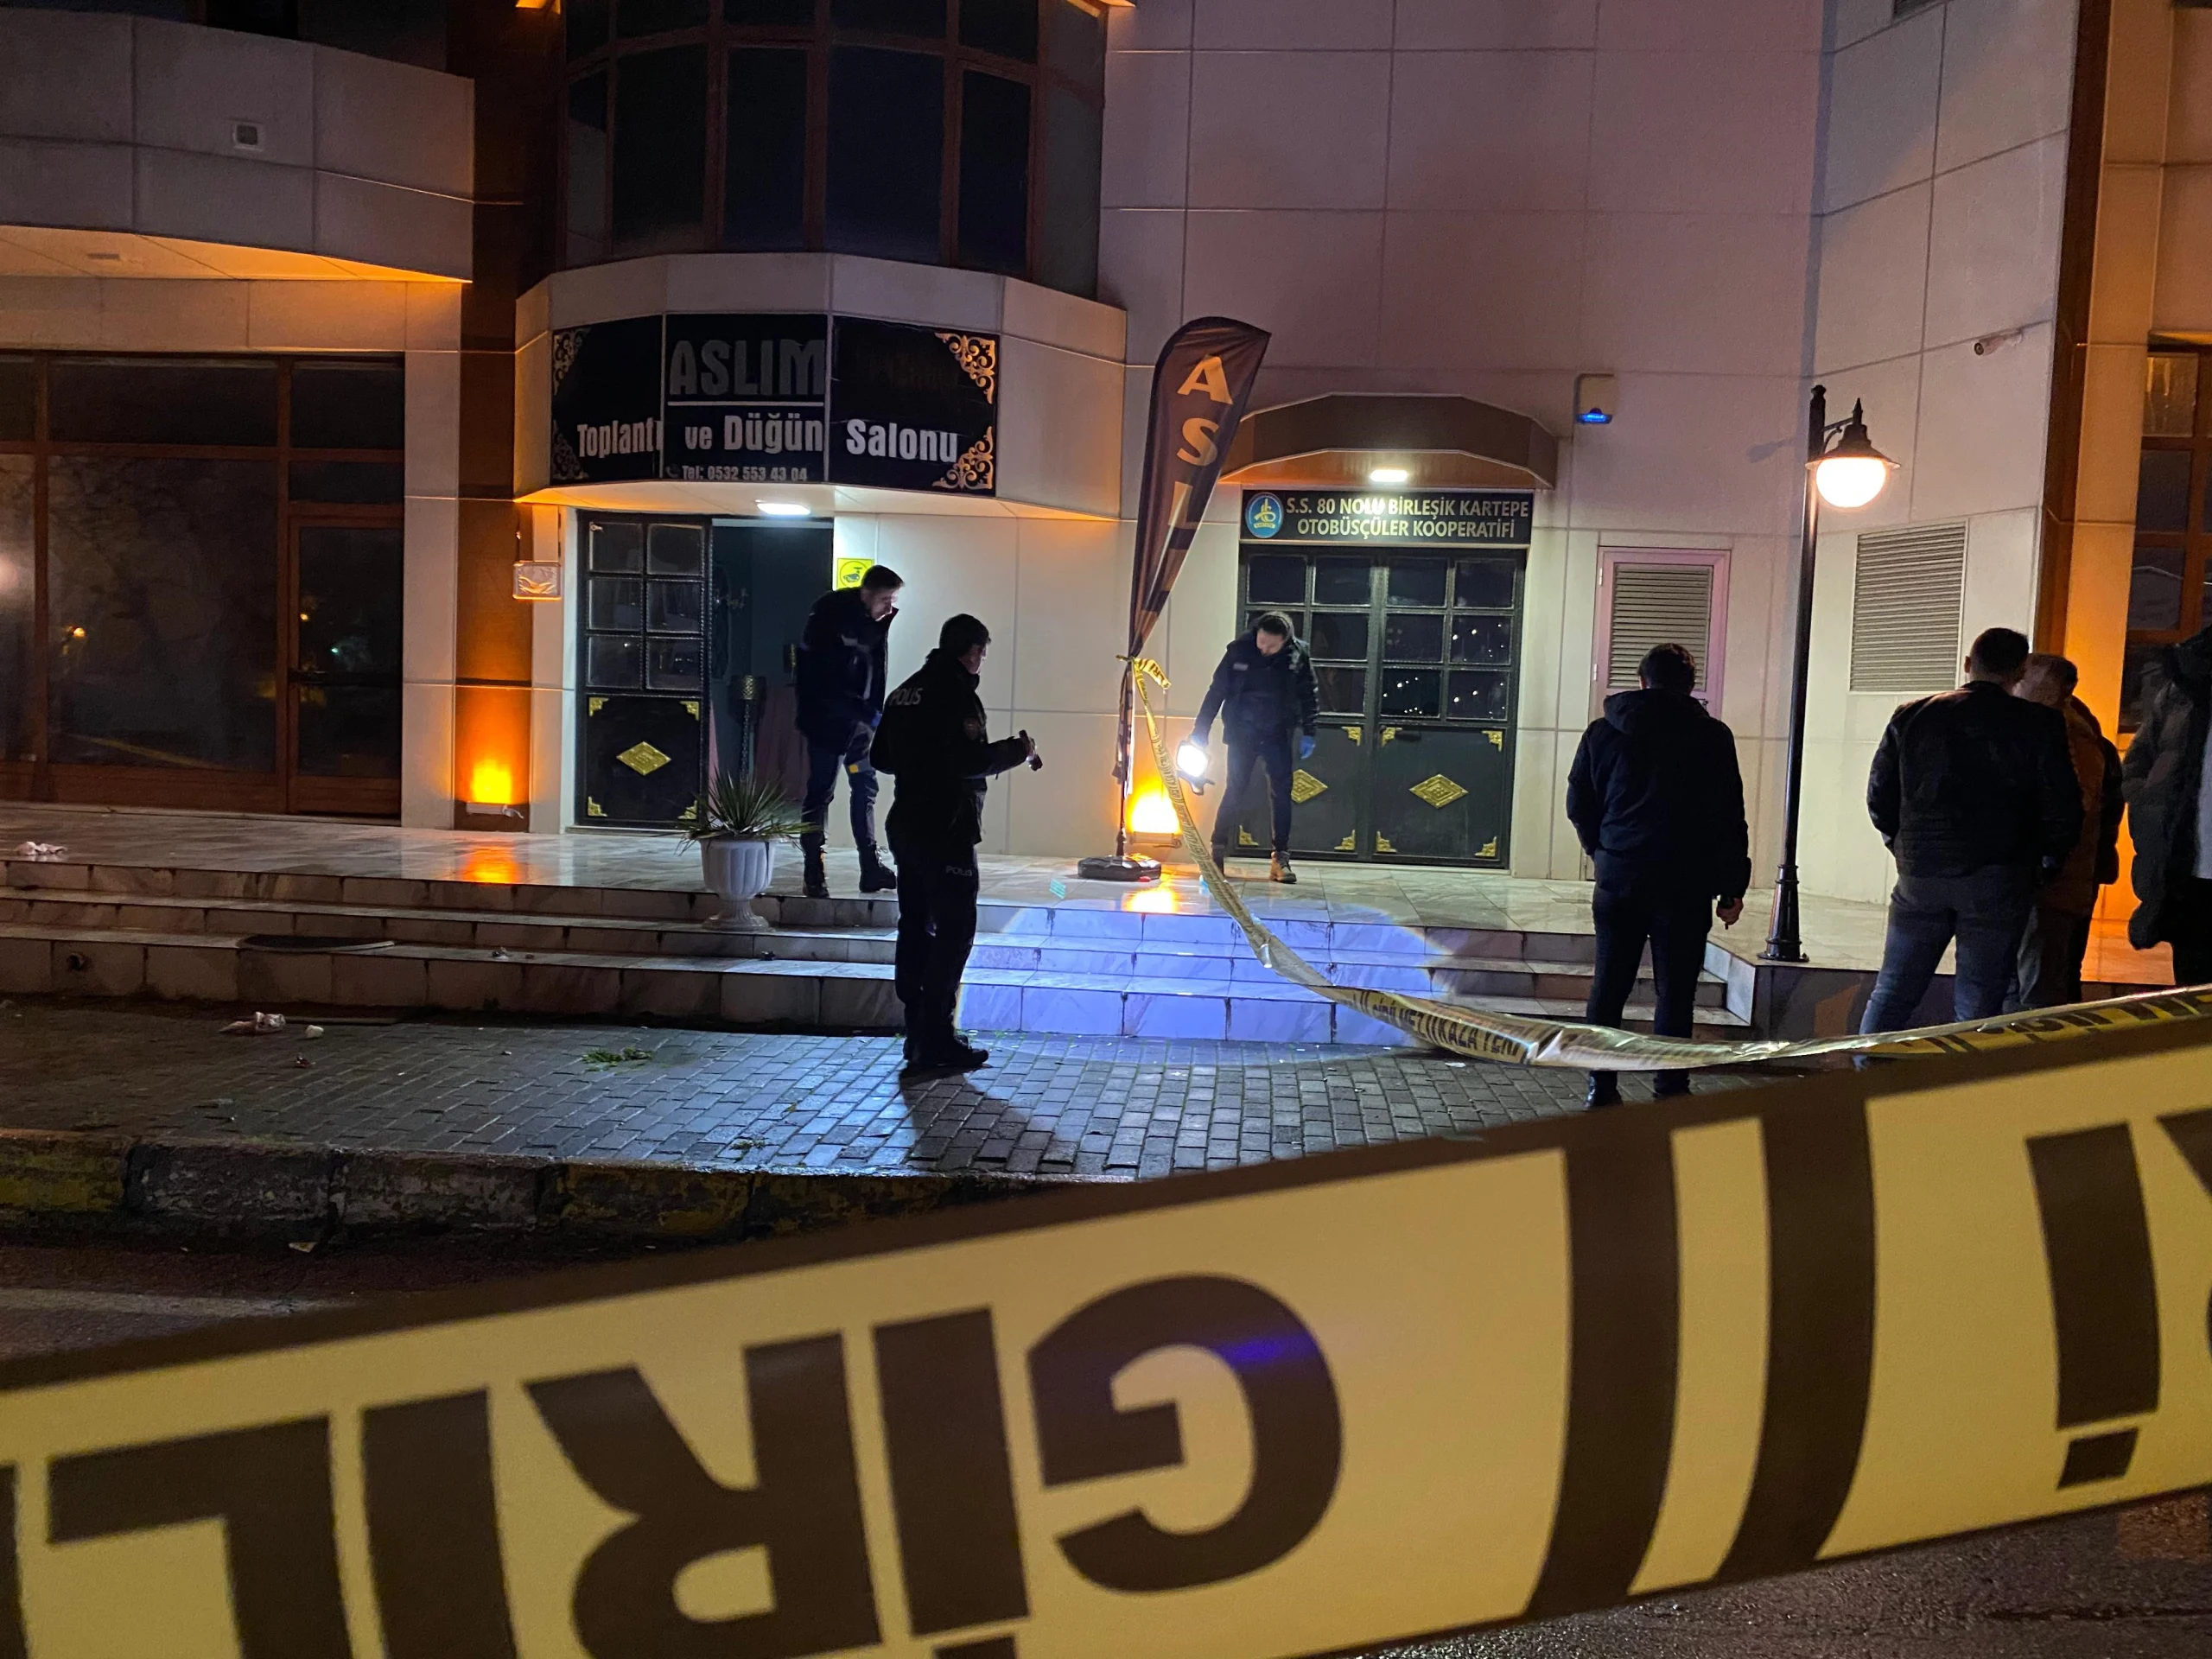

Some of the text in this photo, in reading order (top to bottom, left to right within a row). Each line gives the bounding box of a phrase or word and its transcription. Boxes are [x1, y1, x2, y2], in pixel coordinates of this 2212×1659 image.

[669, 339, 825, 396] ASLIM
[684, 425, 713, 450] ve
[723, 412, 823, 454] Düğün
[845, 418, 958, 463] Salonu
[682, 465, 704, 480] Tel:
[708, 465, 740, 481] 0532
[742, 466, 766, 481] 553
[770, 467, 786, 481] 43
[1286, 495, 1529, 520] S.S. 80 NOLU BİRLEŞİK KARTEPE
[1297, 516, 1515, 540] OTOBÜSÇÜLER KOOPERATİFİ
